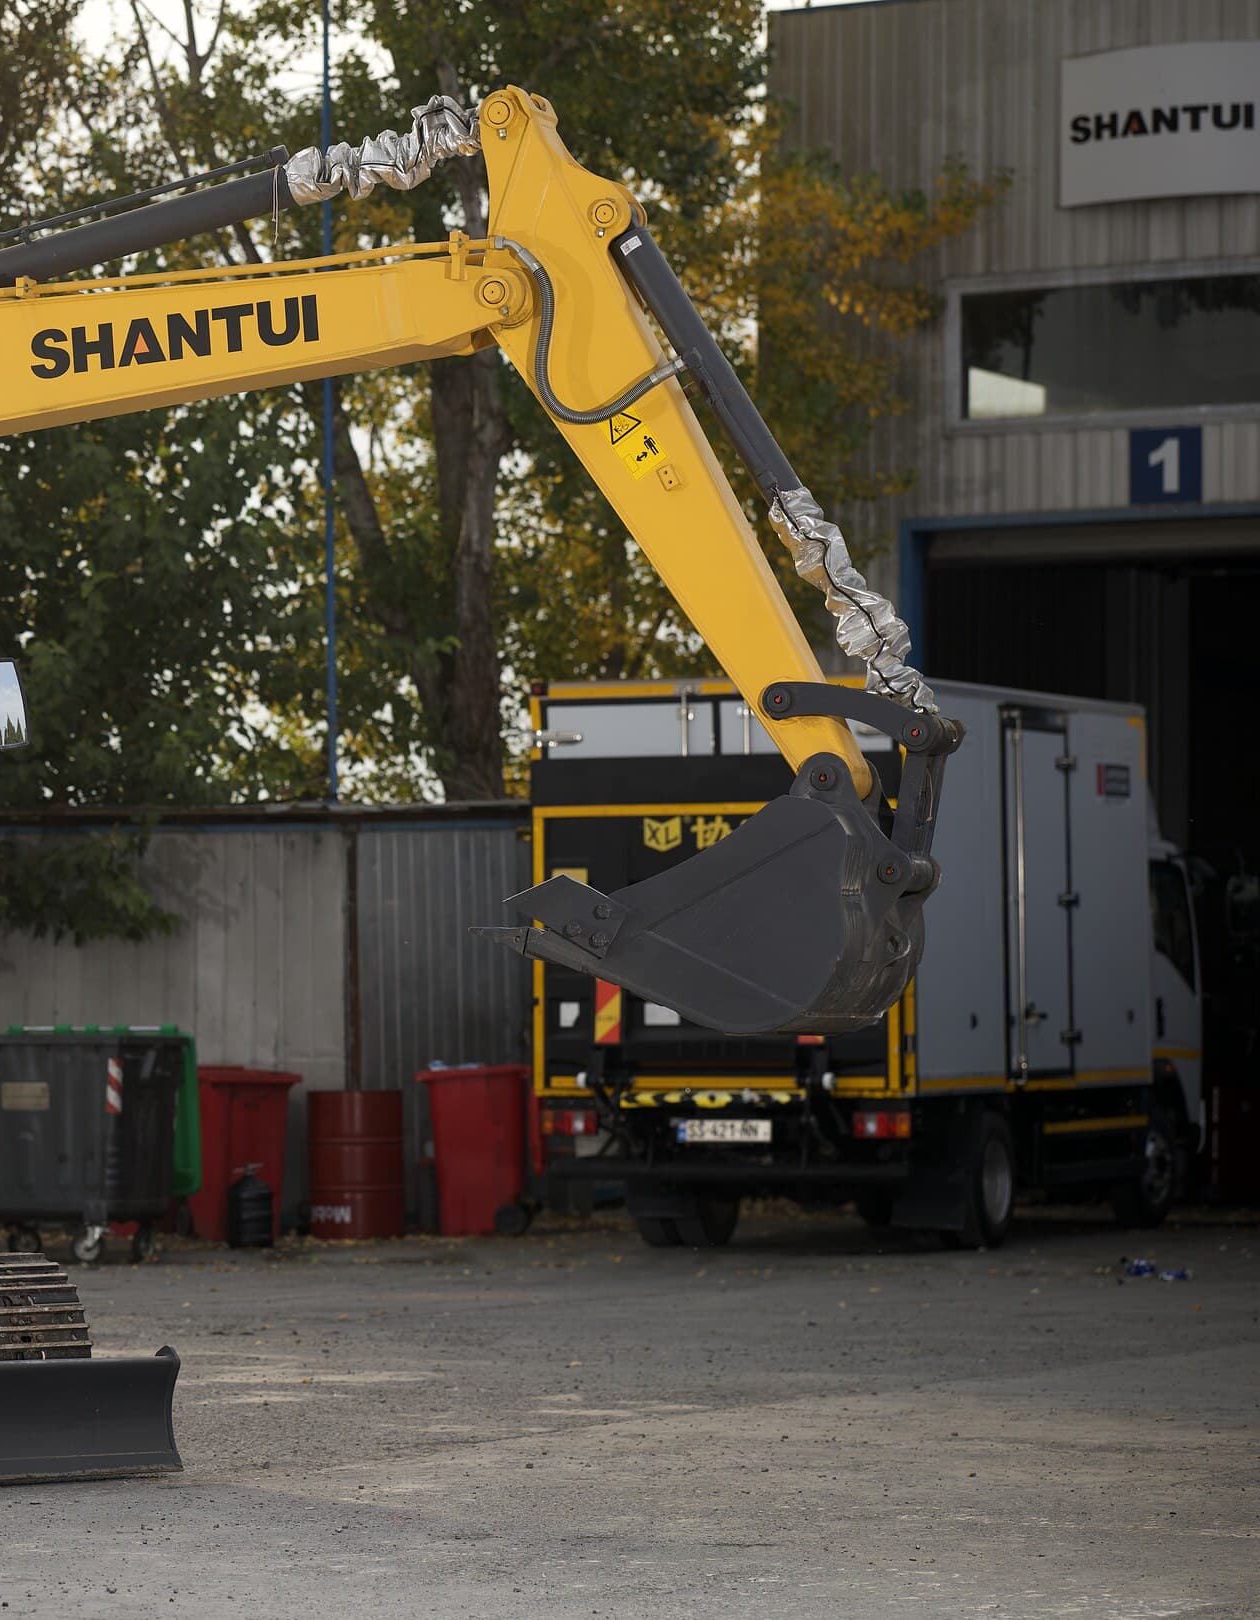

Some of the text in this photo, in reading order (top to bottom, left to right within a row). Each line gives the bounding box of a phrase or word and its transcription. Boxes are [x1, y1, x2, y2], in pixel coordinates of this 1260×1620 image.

[1070, 102, 1255, 144] SHANTUI
[30, 294, 320, 379] SHANTUI
[1148, 437, 1180, 493] 1
